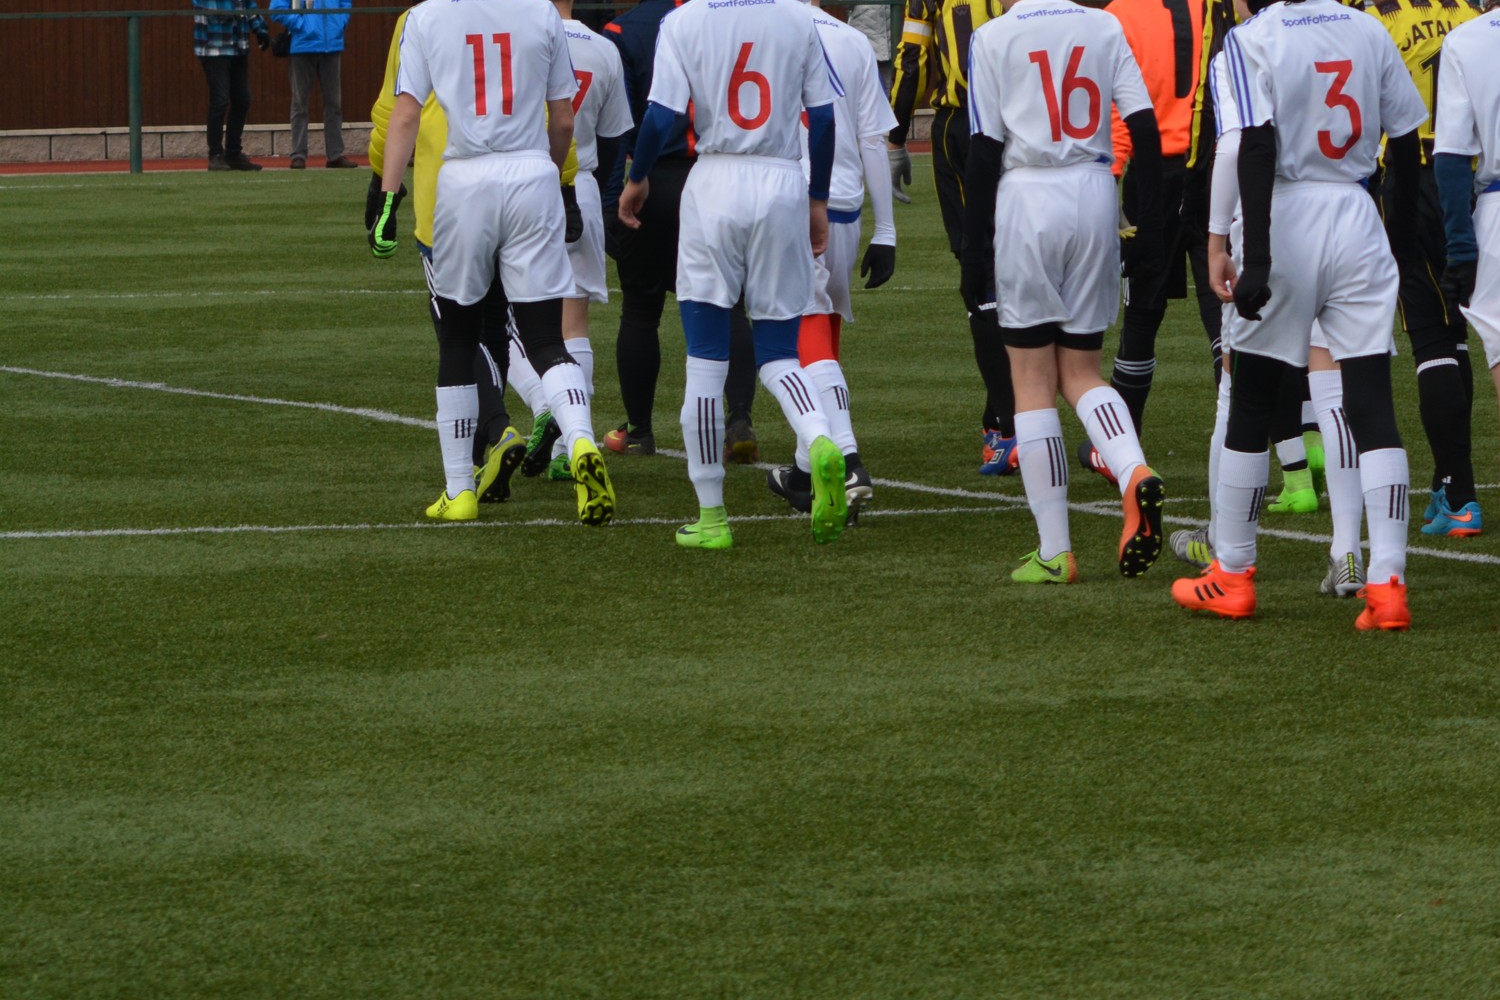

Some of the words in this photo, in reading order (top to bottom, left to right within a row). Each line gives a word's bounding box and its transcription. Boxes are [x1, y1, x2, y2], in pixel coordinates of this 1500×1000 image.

[465, 32, 514, 117] 11
[727, 41, 772, 131] 6
[1028, 45, 1101, 143] 16
[1314, 59, 1362, 160] 3
